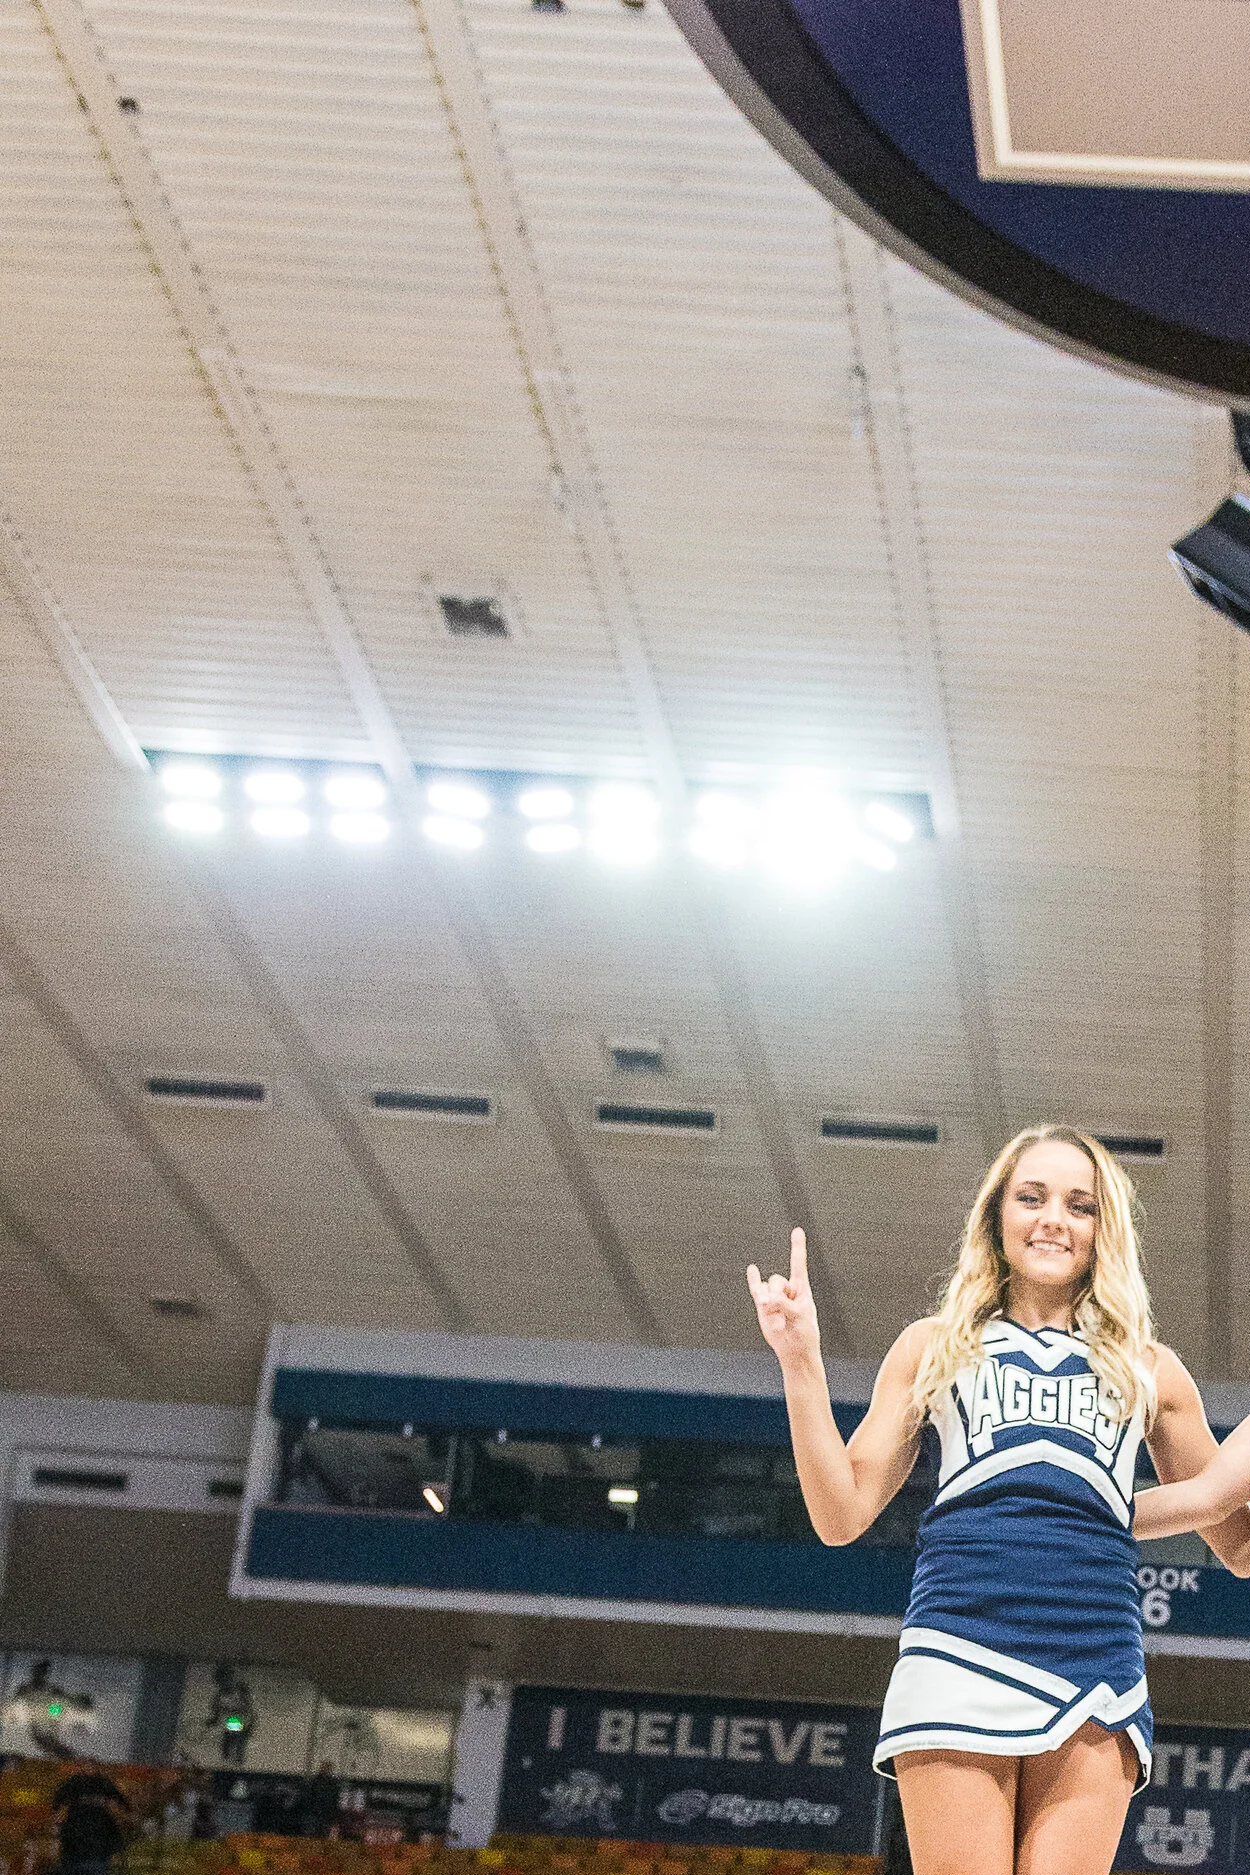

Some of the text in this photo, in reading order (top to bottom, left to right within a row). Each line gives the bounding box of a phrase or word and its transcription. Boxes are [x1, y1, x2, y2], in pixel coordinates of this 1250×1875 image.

[969, 1356, 1125, 1455] AGGIES
[1137, 1567, 1200, 1592] OOK
[547, 1706, 848, 1767] I BELIEVE
